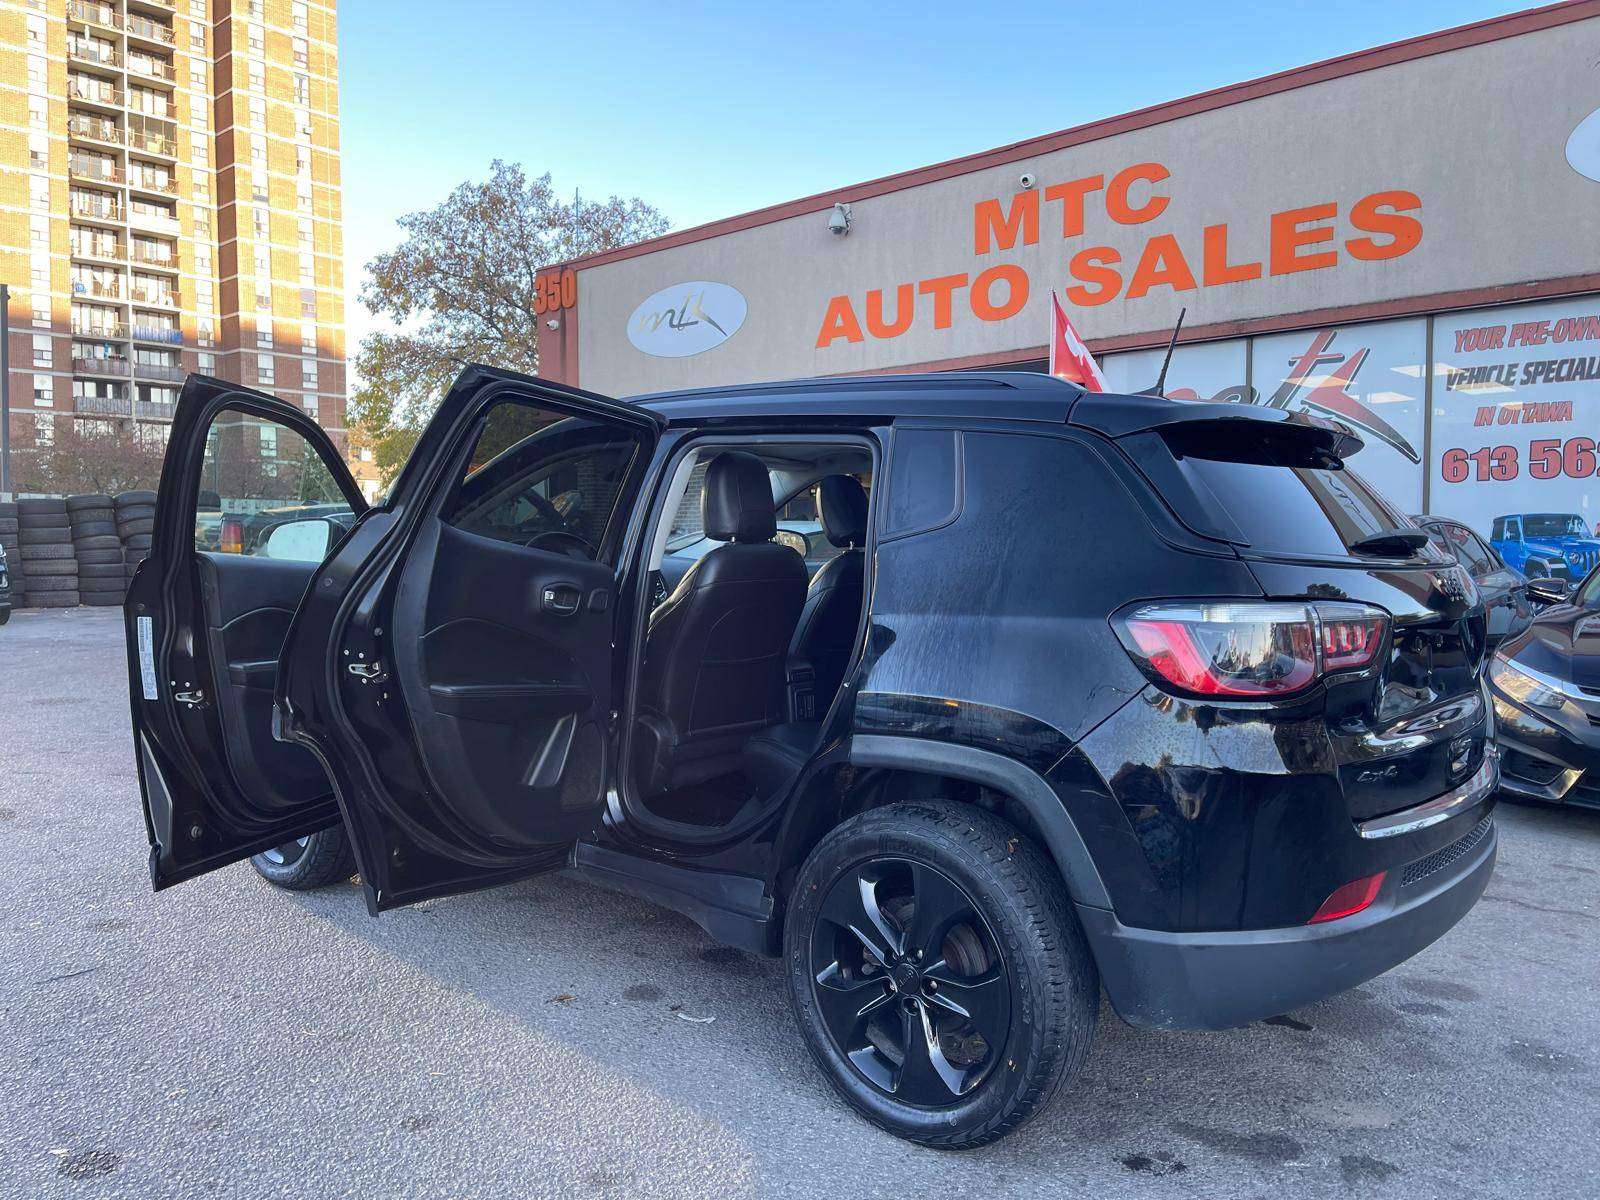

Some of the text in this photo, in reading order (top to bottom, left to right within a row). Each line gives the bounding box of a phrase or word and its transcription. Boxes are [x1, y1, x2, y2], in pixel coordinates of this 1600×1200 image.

[974, 163, 1171, 255] MTC
[534, 268, 576, 315] 350
[816, 190, 1424, 348] AUTO SALES
[1454, 314, 1600, 354] YOUR PRE-OWN
[1446, 362, 1520, 391] VEHICLE
[1473, 400, 1573, 427] IN OTTAWA
[1441, 436, 1600, 483] 613 56
